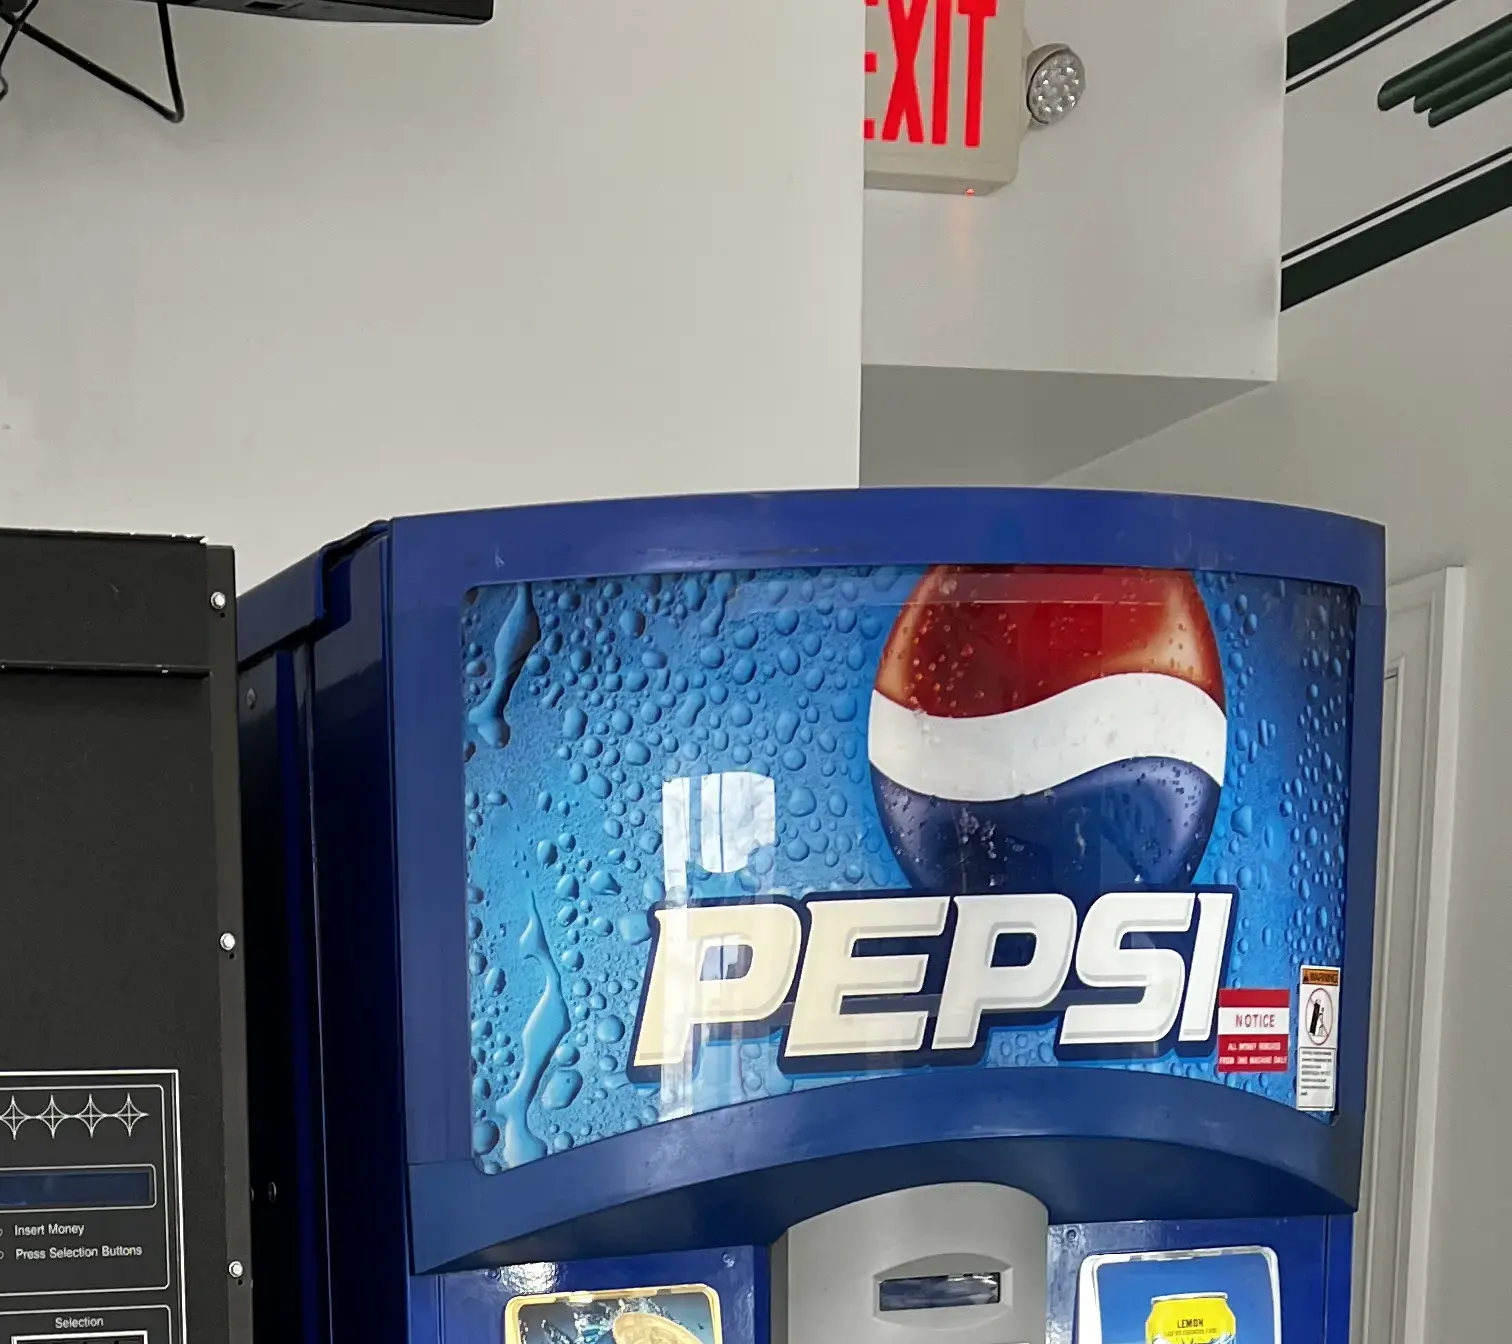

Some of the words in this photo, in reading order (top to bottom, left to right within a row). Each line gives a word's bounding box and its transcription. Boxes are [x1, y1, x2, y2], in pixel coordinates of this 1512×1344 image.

[864, 0, 997, 147] XIT
[632, 891, 1236, 1068] PEPSI
[1235, 1013, 1276, 1028] NOTICE
[14, 1224, 45, 1237] Insert
[49, 1223, 85, 1238] Money
[15, 1248, 46, 1260] Press
[49, 1246, 98, 1259] Selection
[102, 1245, 143, 1257] Buttons
[55, 1316, 104, 1329] Selection
[1176, 1318, 1204, 1329] LEMON
